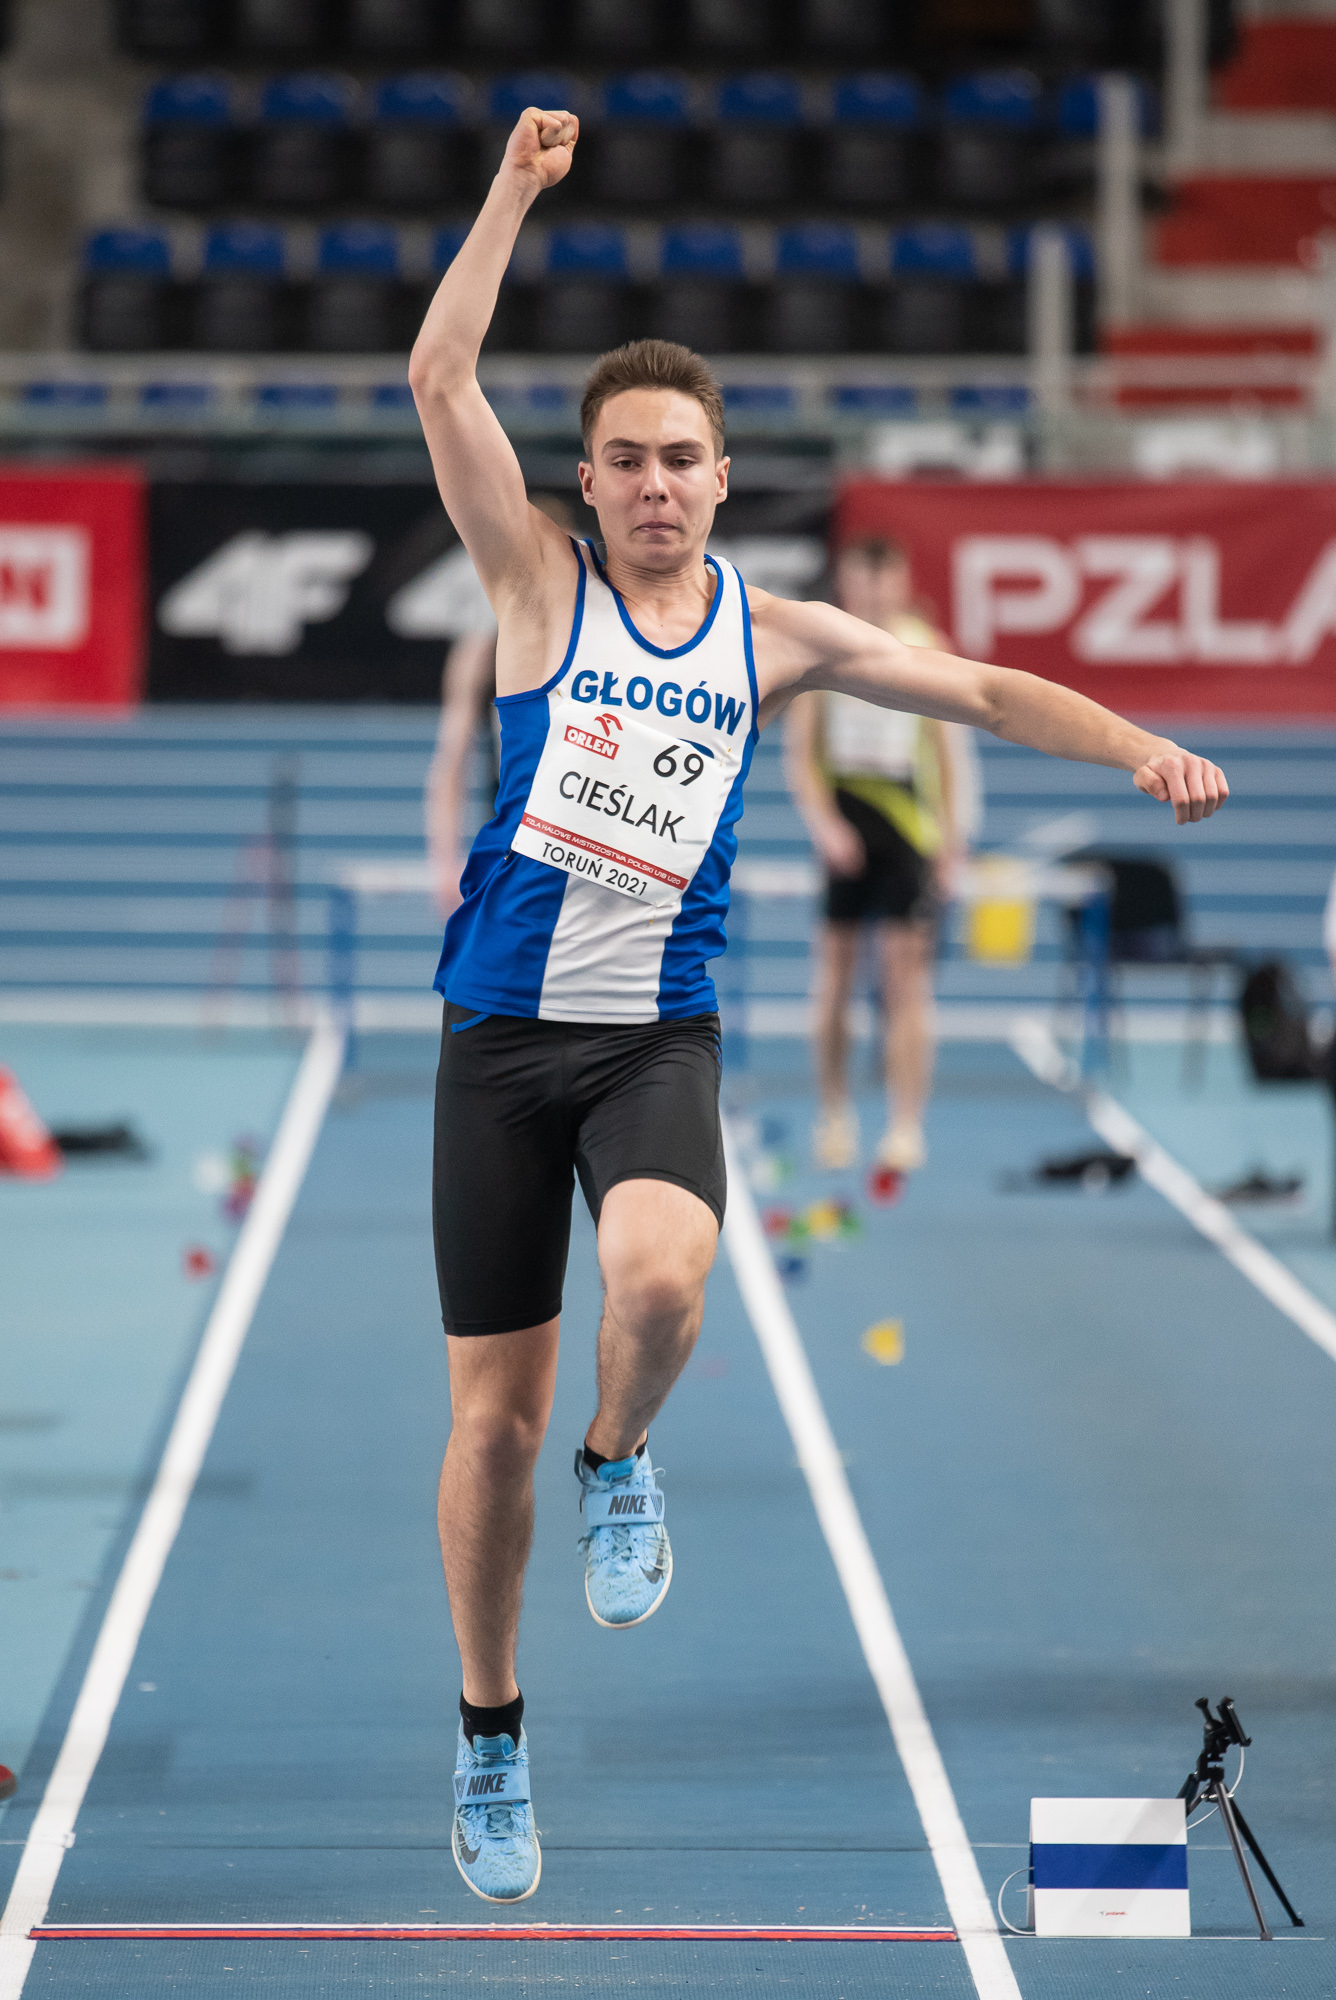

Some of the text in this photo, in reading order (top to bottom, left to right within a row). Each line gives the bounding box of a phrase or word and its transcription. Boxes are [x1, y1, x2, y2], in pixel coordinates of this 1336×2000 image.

[160, 530, 374, 656] 4F
[571, 669, 747, 736] GŁOGÓW
[567, 729, 616, 756] ORLEN
[653, 744, 705, 787] 69
[559, 771, 686, 843] CIEŚLAK
[525, 817, 541, 829] PZLA
[541, 824, 571, 841] HALOWE
[572, 836, 627, 862] MISTRZOSTWA
[627, 858, 655, 874] POLSKI
[667, 876, 682, 885] U20
[543, 842, 648, 896] TORUŃ 2021
[607, 1495, 648, 1516] NIKE
[467, 1772, 508, 1797] NIKE
